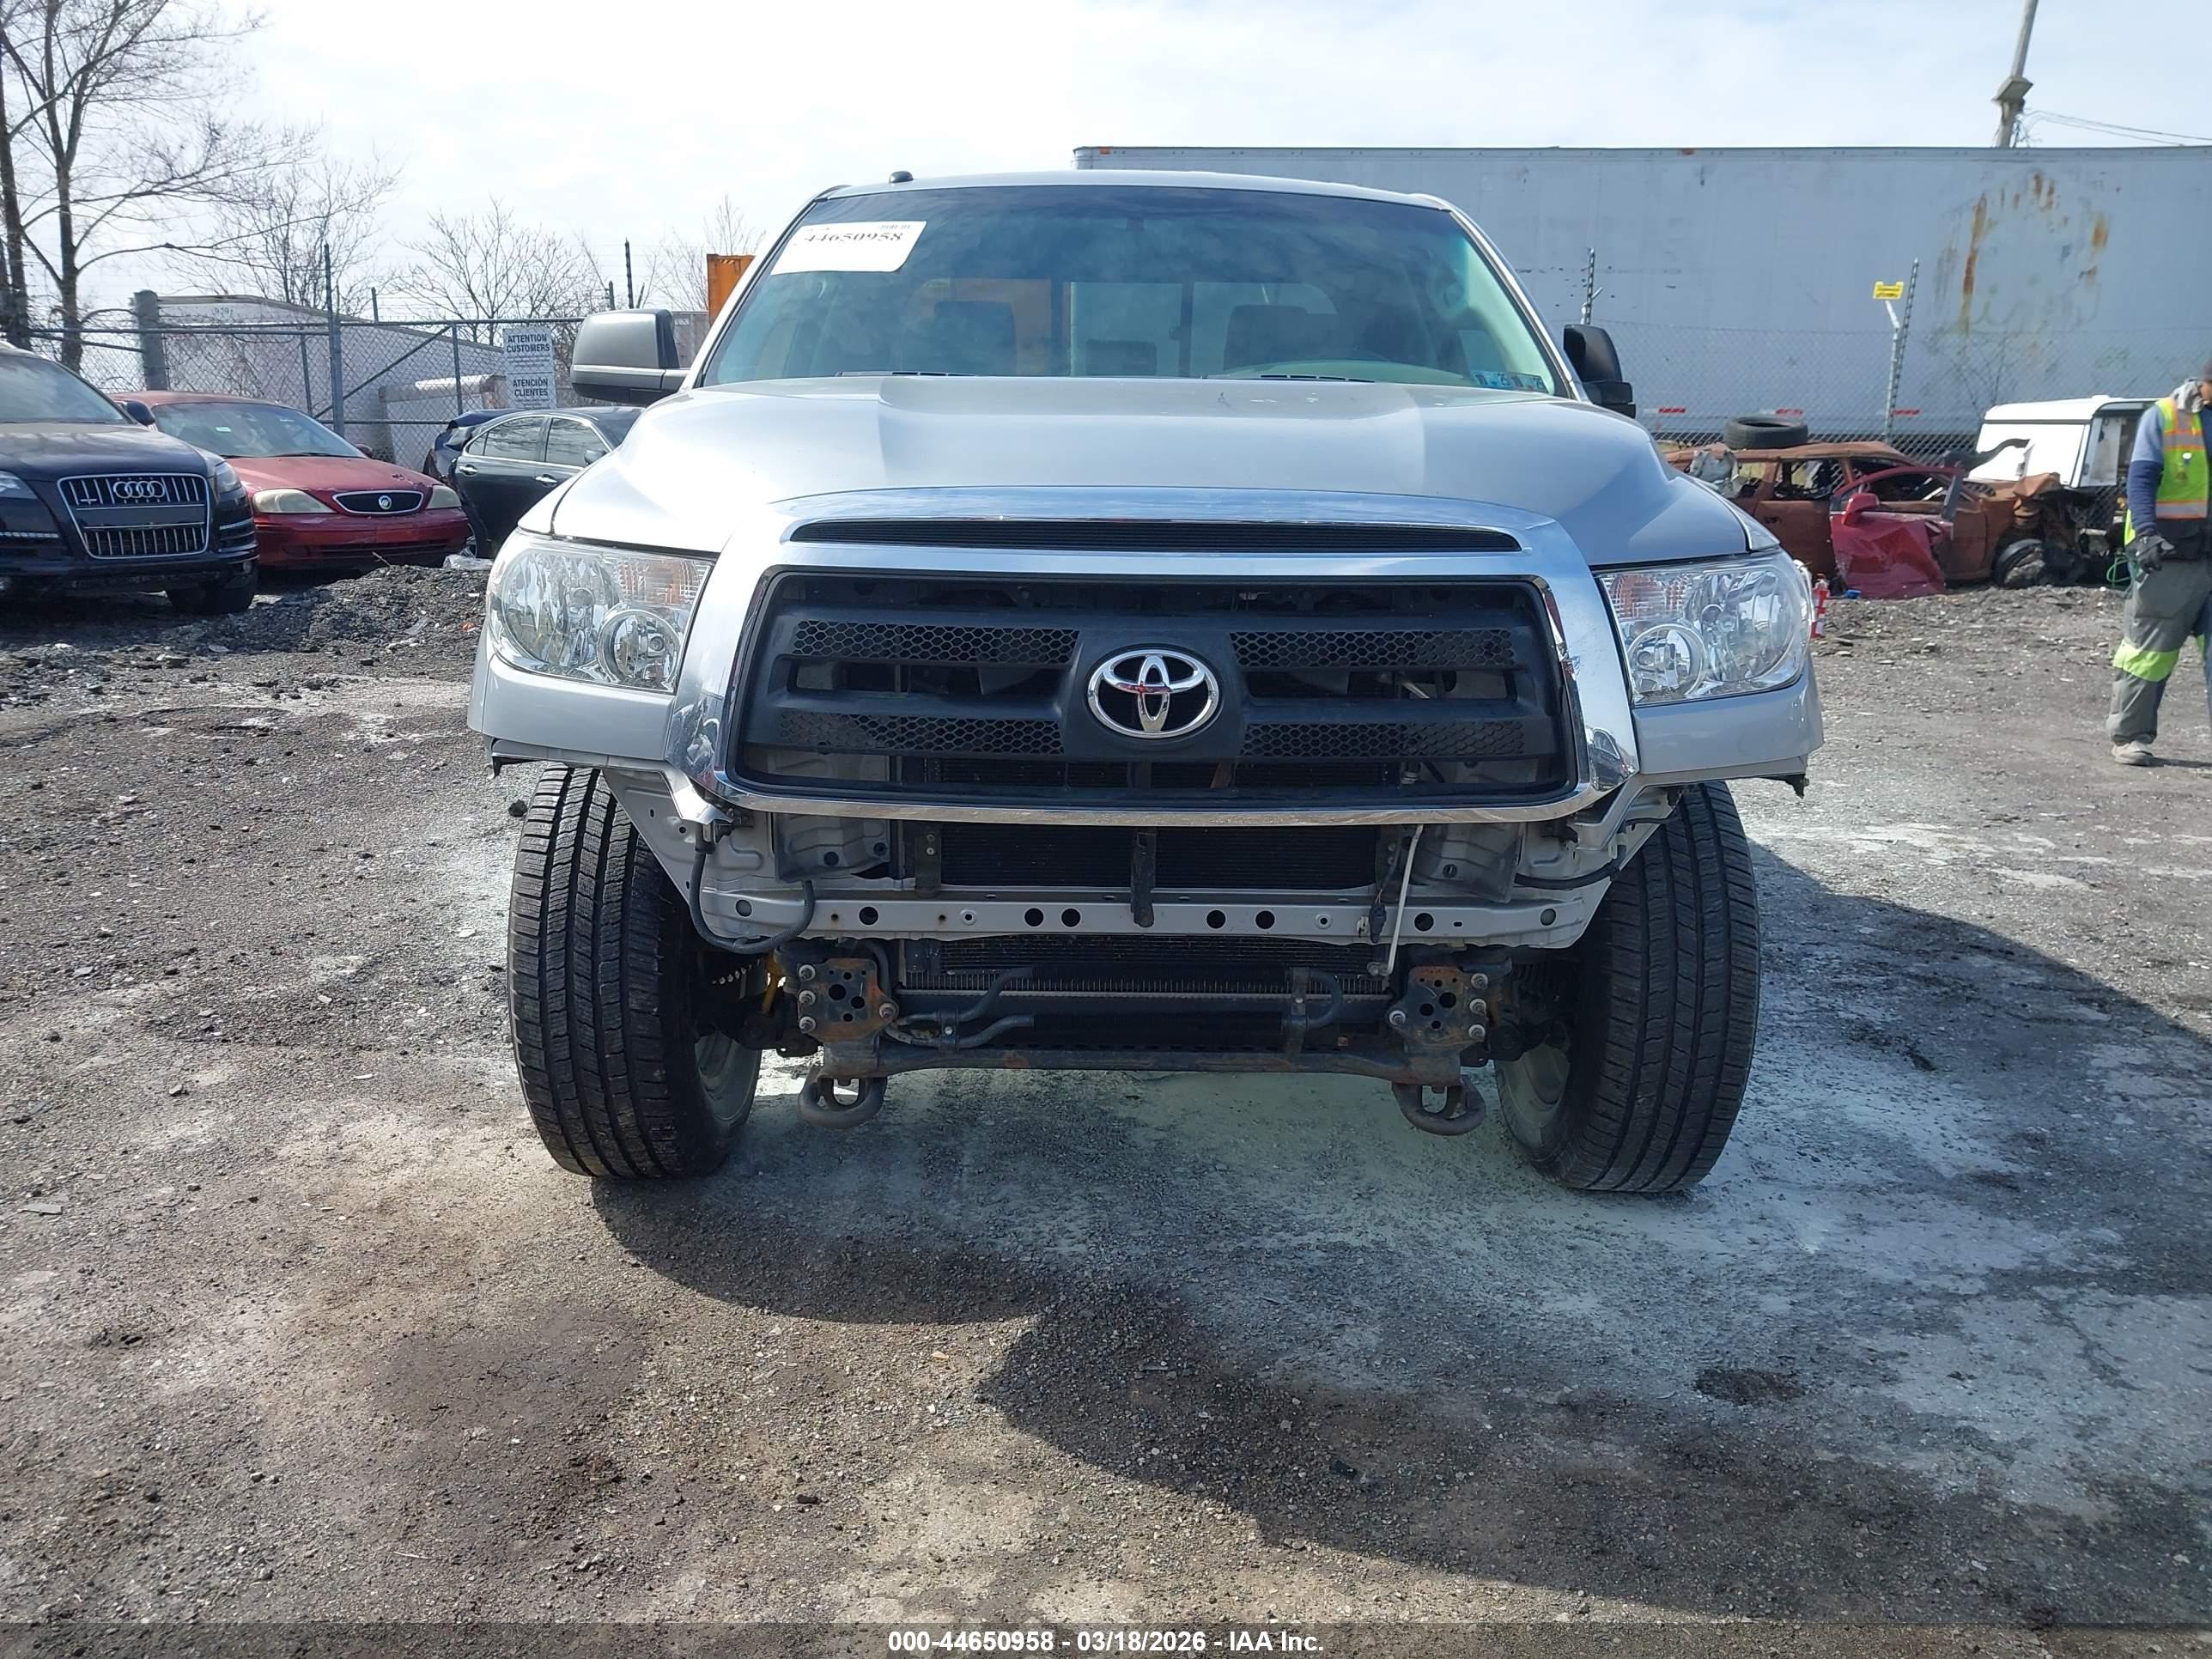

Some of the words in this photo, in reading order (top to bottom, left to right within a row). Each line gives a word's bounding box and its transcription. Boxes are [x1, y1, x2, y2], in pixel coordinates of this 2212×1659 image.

[804, 233, 903, 241] 44650958
[507, 334, 547, 343] ATTENTION
[507, 343, 550, 353] CUSTOMERS
[513, 377, 549, 387] ATENCIÓN
[514, 388, 548, 397] CLIENTES
